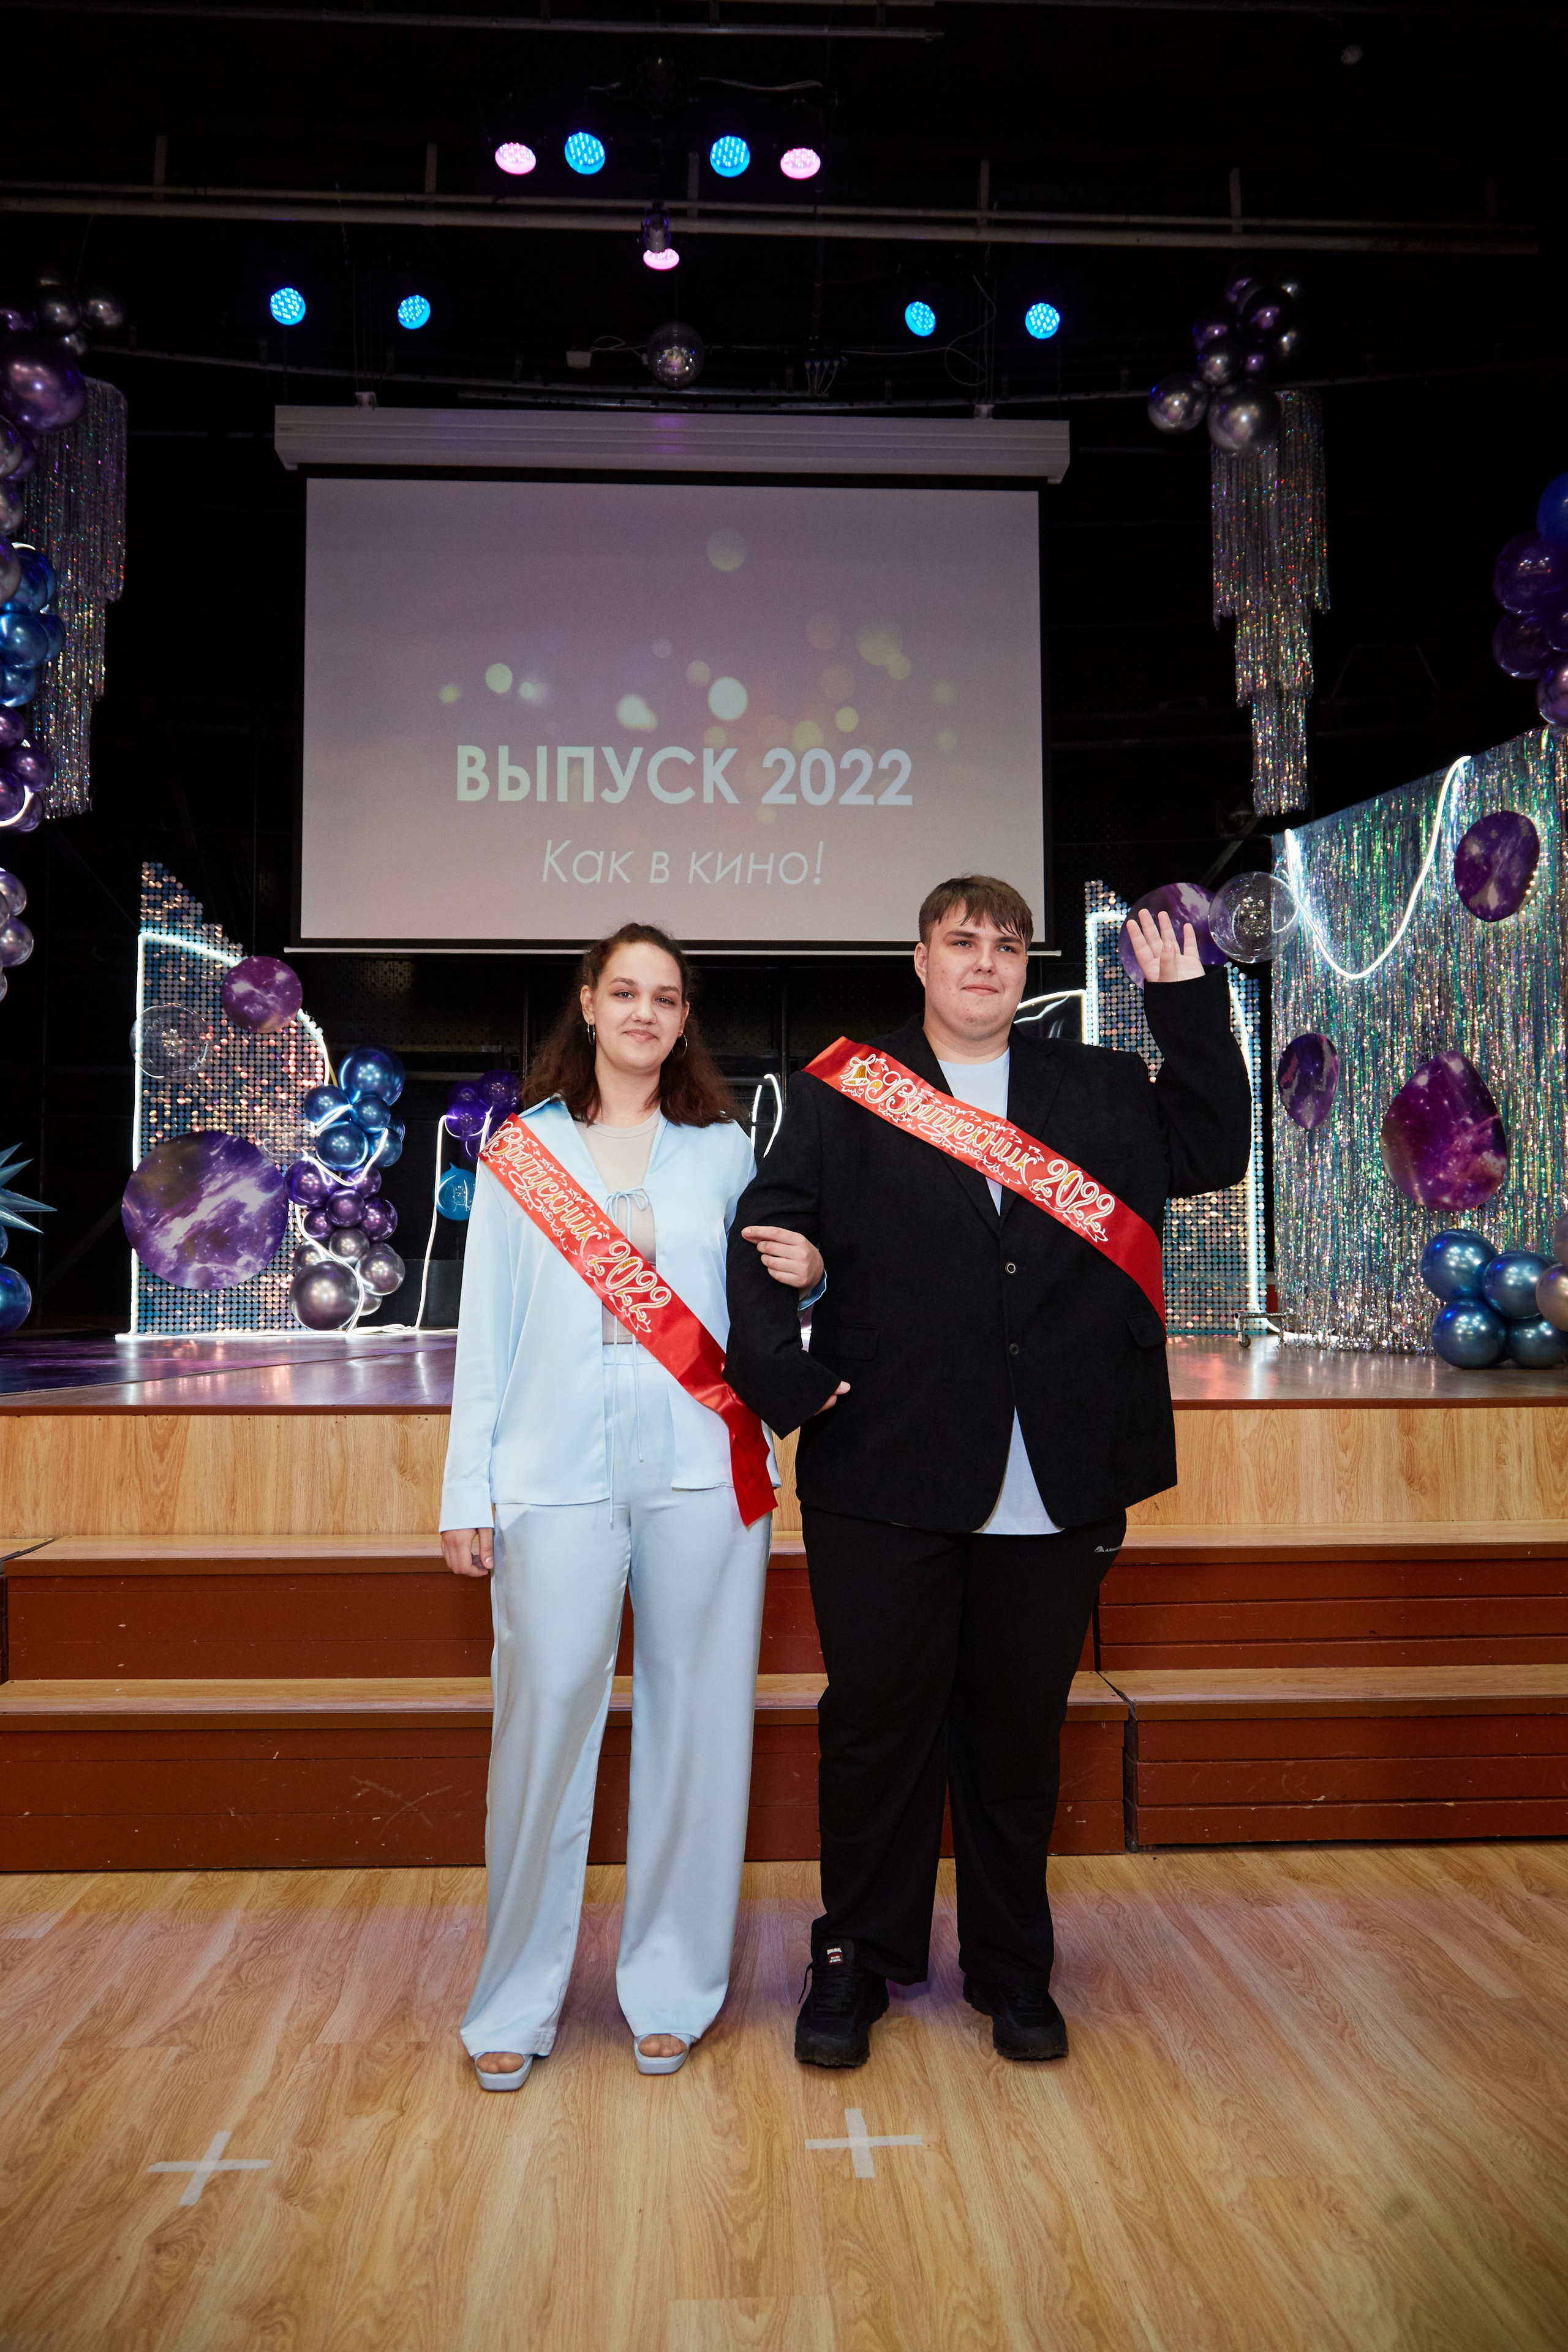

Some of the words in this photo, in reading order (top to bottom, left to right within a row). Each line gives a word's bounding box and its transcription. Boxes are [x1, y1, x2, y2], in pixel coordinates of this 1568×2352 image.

[456, 744, 740, 804] ВЫПУСК
[761, 747, 913, 805] 2022
[542, 839, 634, 883] Как
[649, 851, 670, 883] в
[687, 841, 824, 886] кино!
[864, 1071, 1038, 1186] Выпускник
[1032, 1159, 1115, 1232] 2022
[484, 1120, 602, 1259] Выпускник
[586, 1240, 672, 1322] 2022
